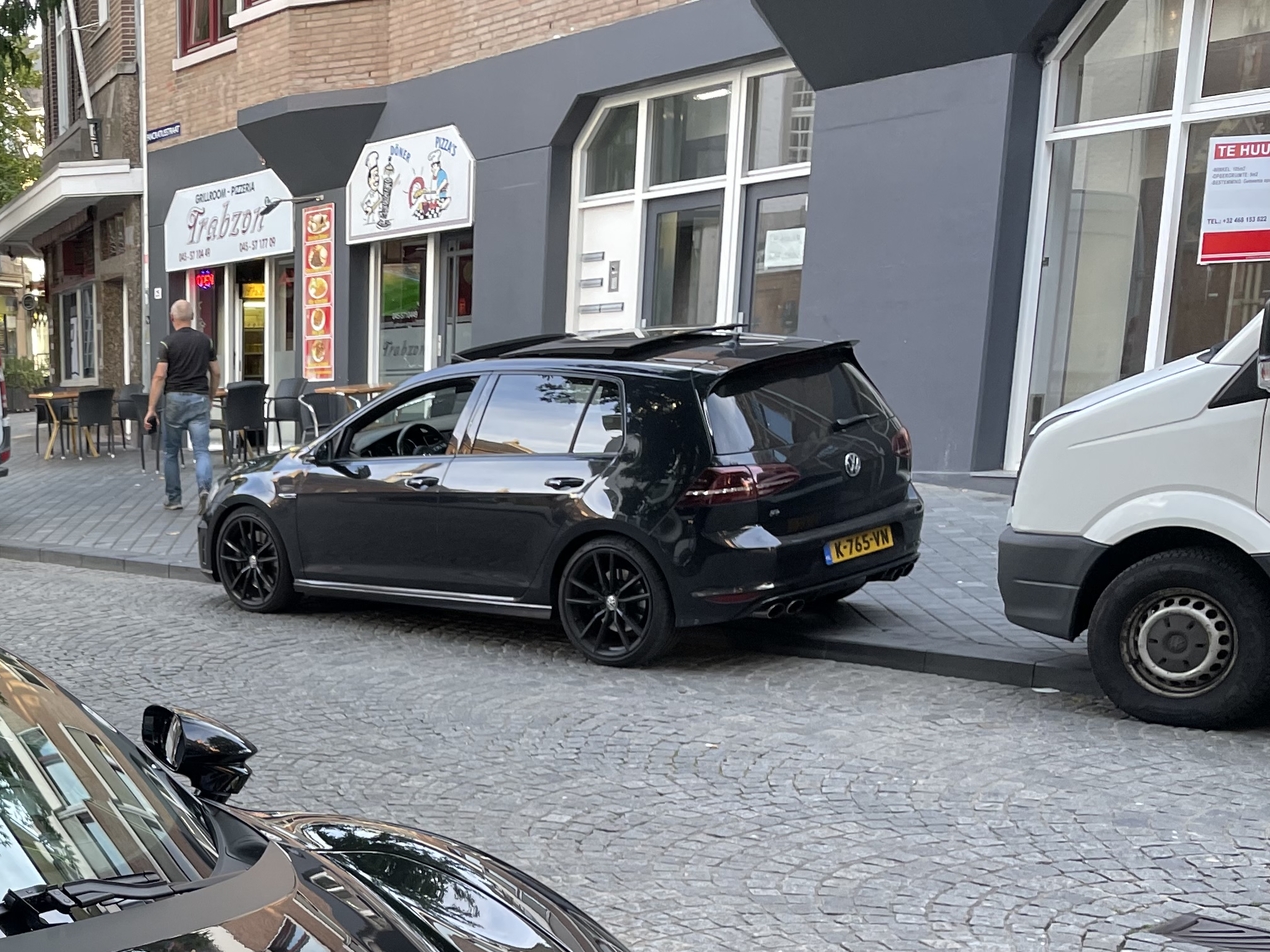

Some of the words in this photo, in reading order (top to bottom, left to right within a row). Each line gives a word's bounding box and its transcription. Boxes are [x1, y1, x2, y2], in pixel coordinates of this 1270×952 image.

[390, 144, 411, 163] DÖNER
[435, 136, 457, 157] PIZZA'S
[1218, 145, 1236, 157] TE
[195, 187, 227, 204] GRILLROOM
[231, 182, 255, 196] PIZZERIA
[187, 200, 266, 246] Trabzon
[834, 527, 890, 559] K-765-VN
